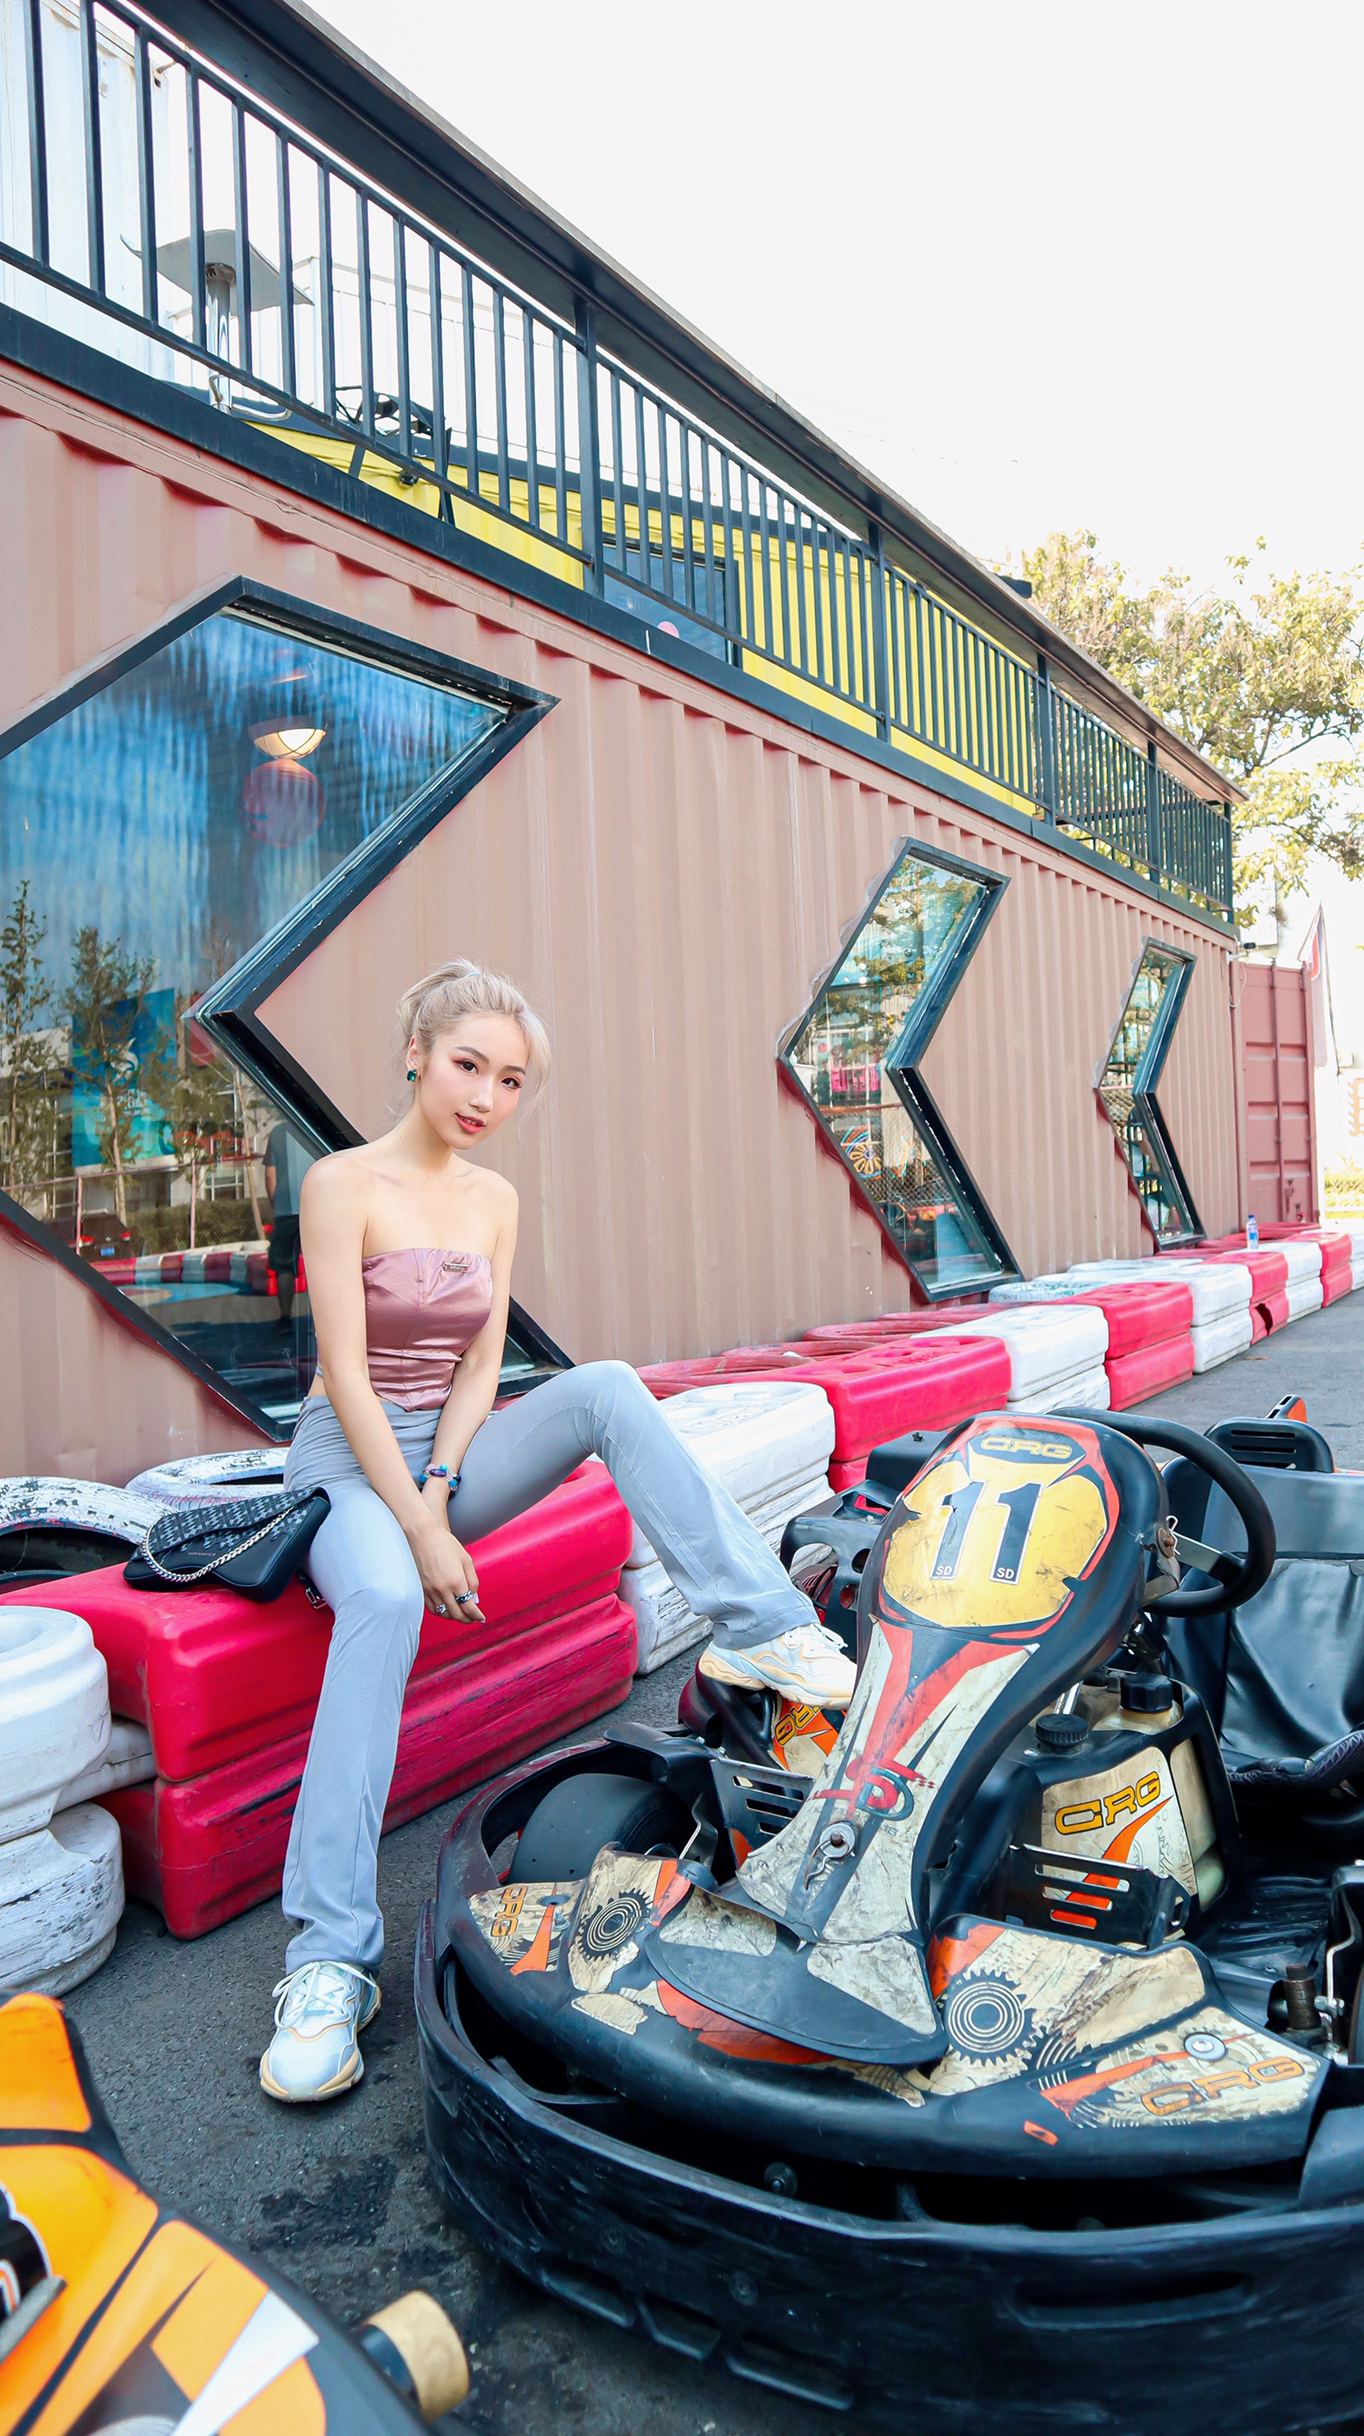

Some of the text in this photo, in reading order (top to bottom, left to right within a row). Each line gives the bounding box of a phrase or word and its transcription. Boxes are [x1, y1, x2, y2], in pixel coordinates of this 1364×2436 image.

[981, 1437, 1072, 1459] CRG
[929, 1480, 1044, 1585] 11
[936, 1565, 953, 1576] SD
[996, 1567, 1015, 1580] SD
[775, 1704, 820, 1747] RG
[1054, 1770, 1160, 1835] CRG
[490, 1886, 529, 1937] CRG
[1141, 2056, 1306, 2117] CRG
